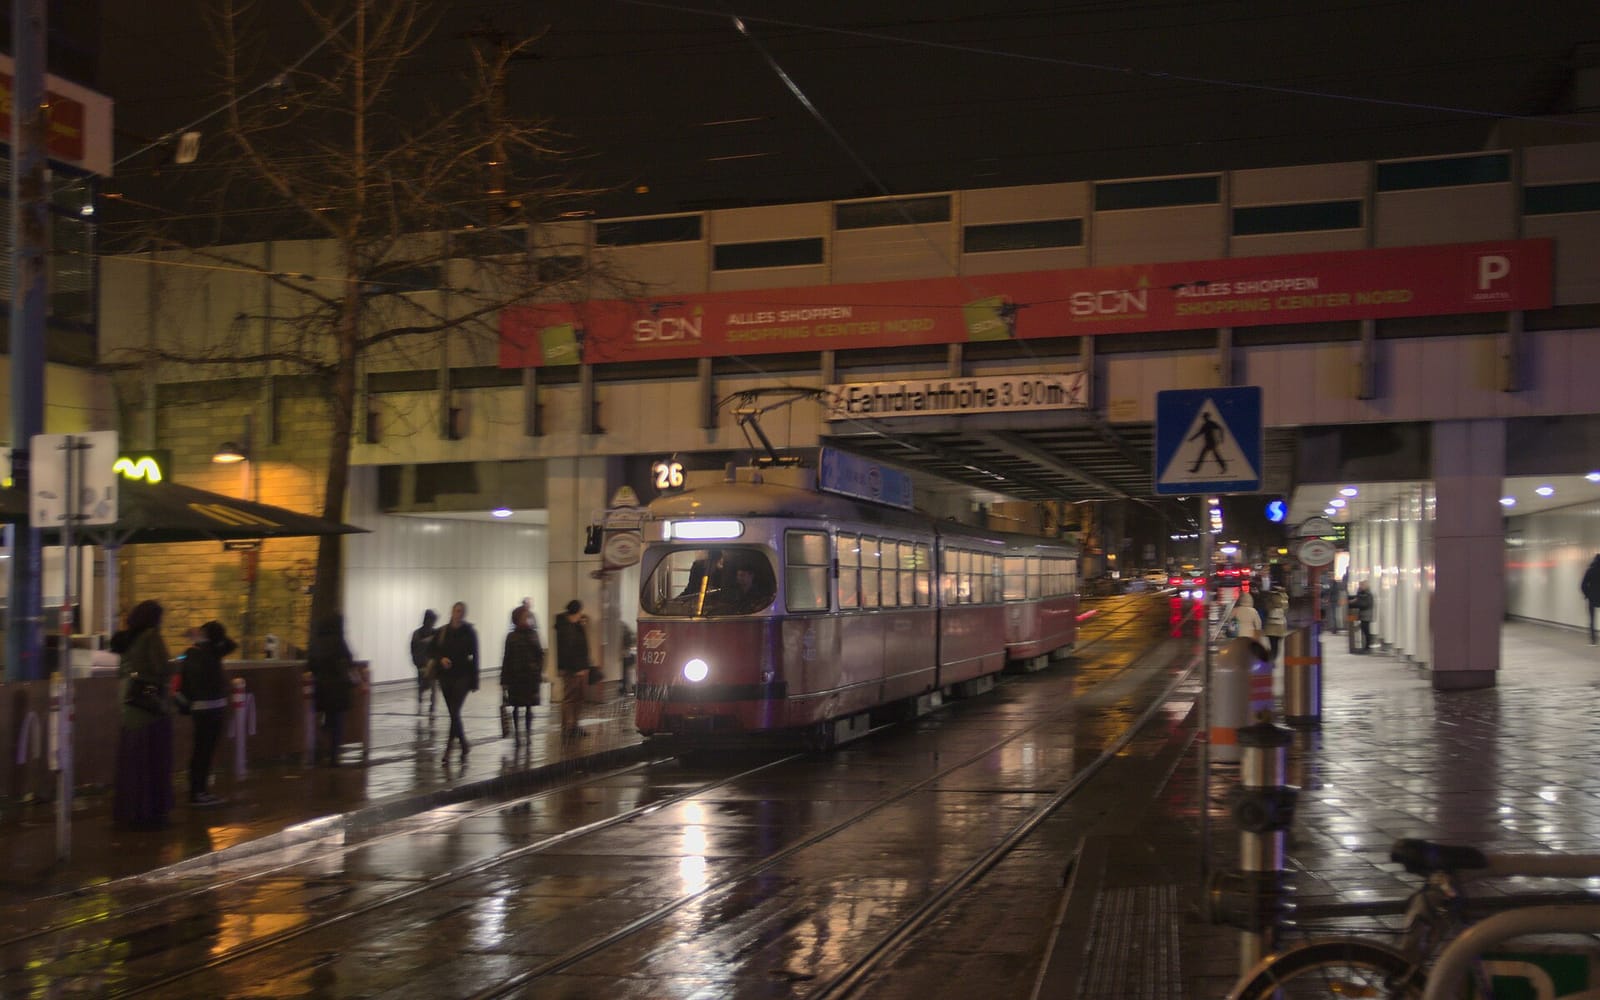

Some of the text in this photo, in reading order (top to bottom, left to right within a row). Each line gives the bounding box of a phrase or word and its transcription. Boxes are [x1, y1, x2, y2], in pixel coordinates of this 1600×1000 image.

[1478, 255, 1511, 290] P
[1177, 277, 1319, 297] ALLES SHOPPEN
[1070, 289, 1148, 315] SCN
[1175, 289, 1414, 316] SHOPPING CENTER NORD
[727, 306, 853, 325] ALLES SHOPPEN
[633, 316, 703, 341] SCN
[727, 318, 935, 342] SHOPPING CENTER NORD
[848, 380, 1065, 412] Fahrdrahthöhe 3.90m
[654, 462, 684, 489] 26
[642, 650, 666, 665] 4827
